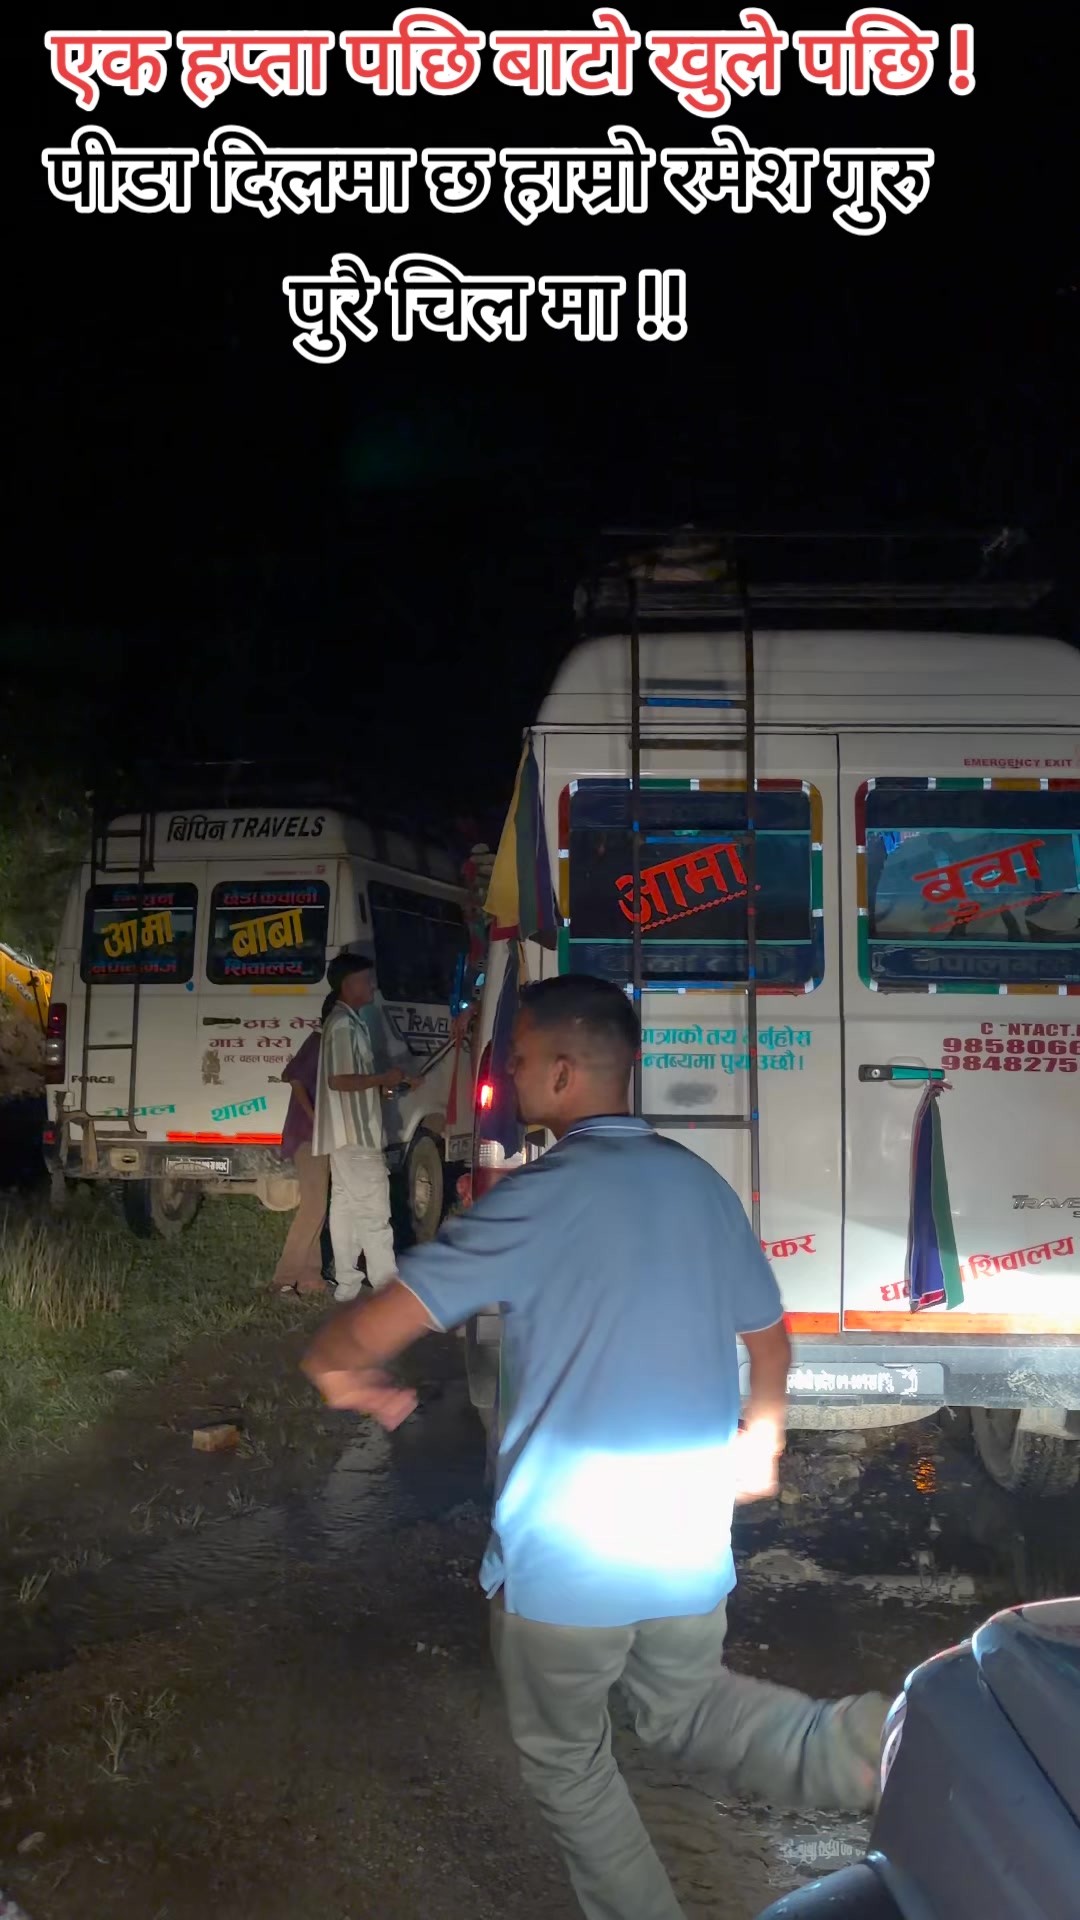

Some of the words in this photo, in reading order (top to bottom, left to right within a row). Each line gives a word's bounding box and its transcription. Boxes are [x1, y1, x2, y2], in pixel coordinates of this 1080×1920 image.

[963, 758, 1040, 768] EMERGENCY
[1044, 758, 1073, 768] EXIT
[167, 814, 229, 842] बिपिन
[231, 815, 326, 839] TRAVELS
[614, 842, 749, 925] आमा
[101, 910, 174, 959] आमा
[230, 907, 304, 959] बाबा
[256, 1036, 292, 1048] तेरो
[968, 1236, 1075, 1279] शिवालय
